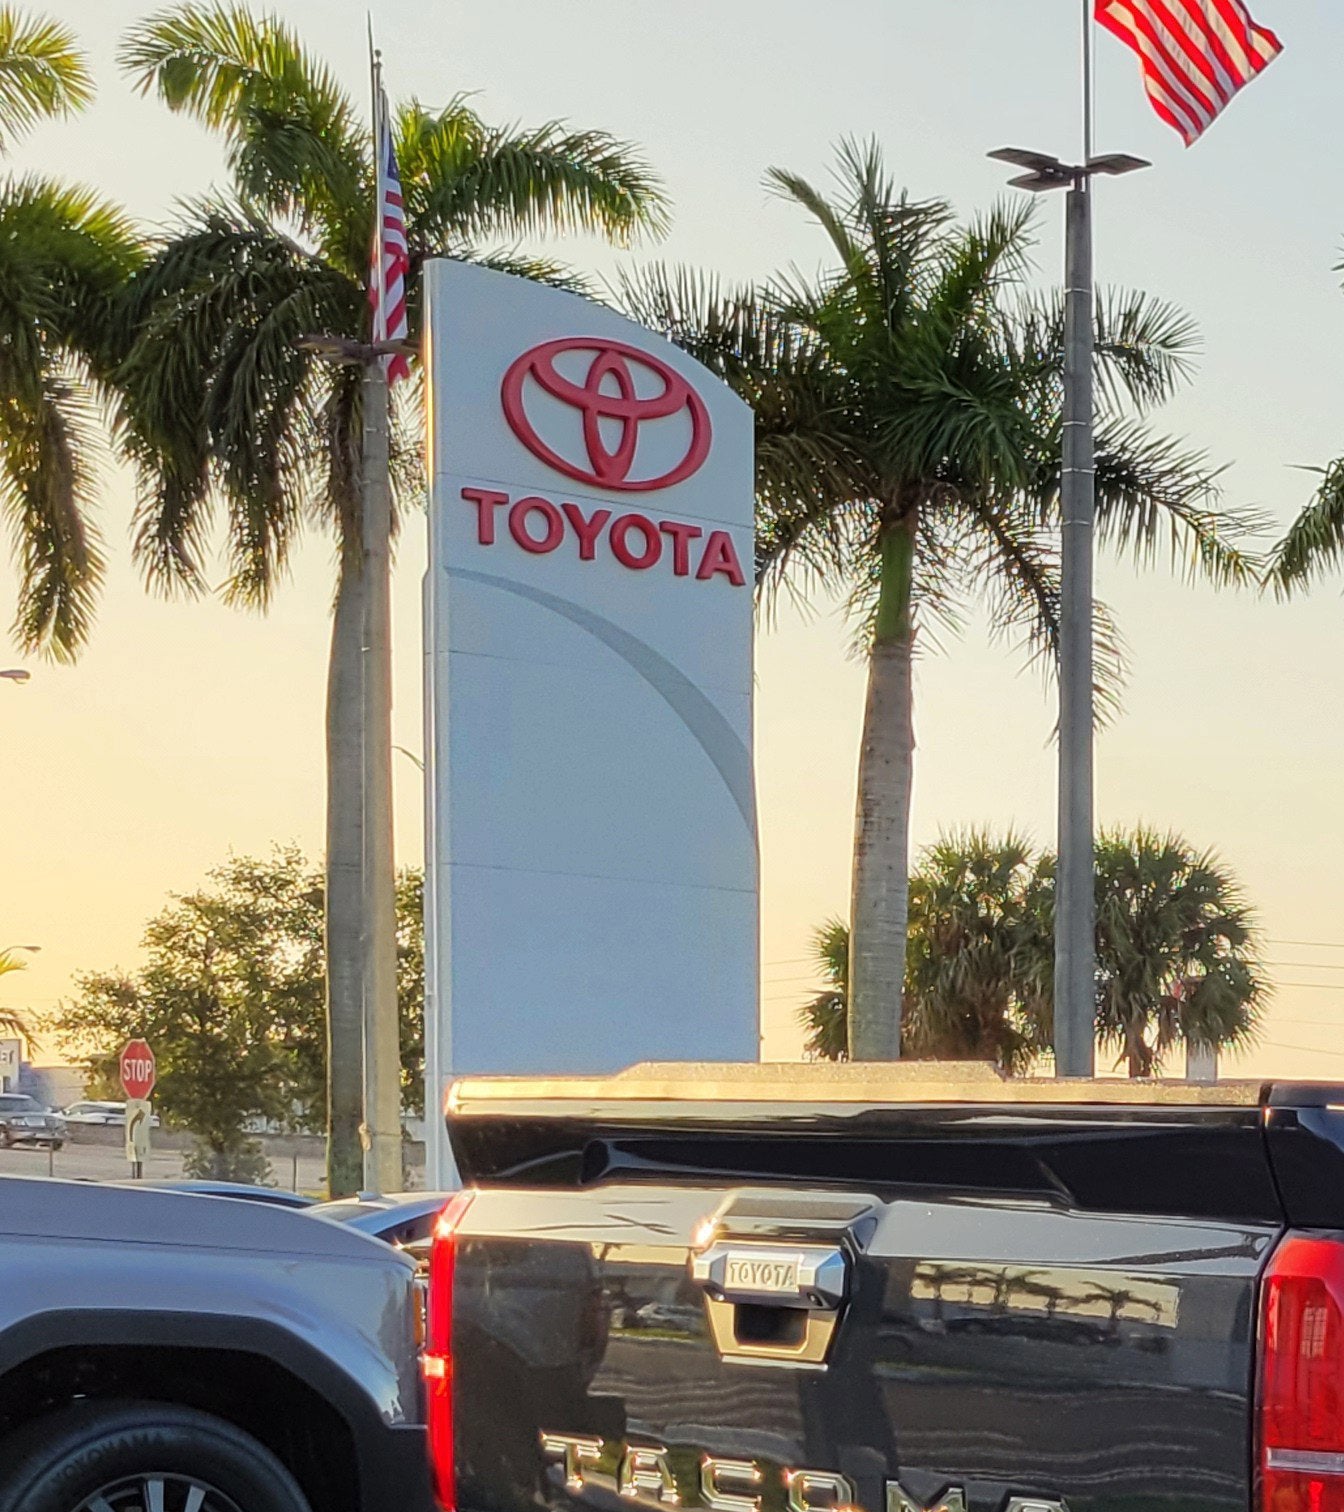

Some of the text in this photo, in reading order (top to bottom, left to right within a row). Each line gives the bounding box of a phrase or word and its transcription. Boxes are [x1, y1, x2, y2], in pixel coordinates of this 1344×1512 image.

[461, 487, 746, 586] TOYOTA
[123, 1058, 152, 1082] STOP
[729, 1262, 794, 1287] TOYOTA
